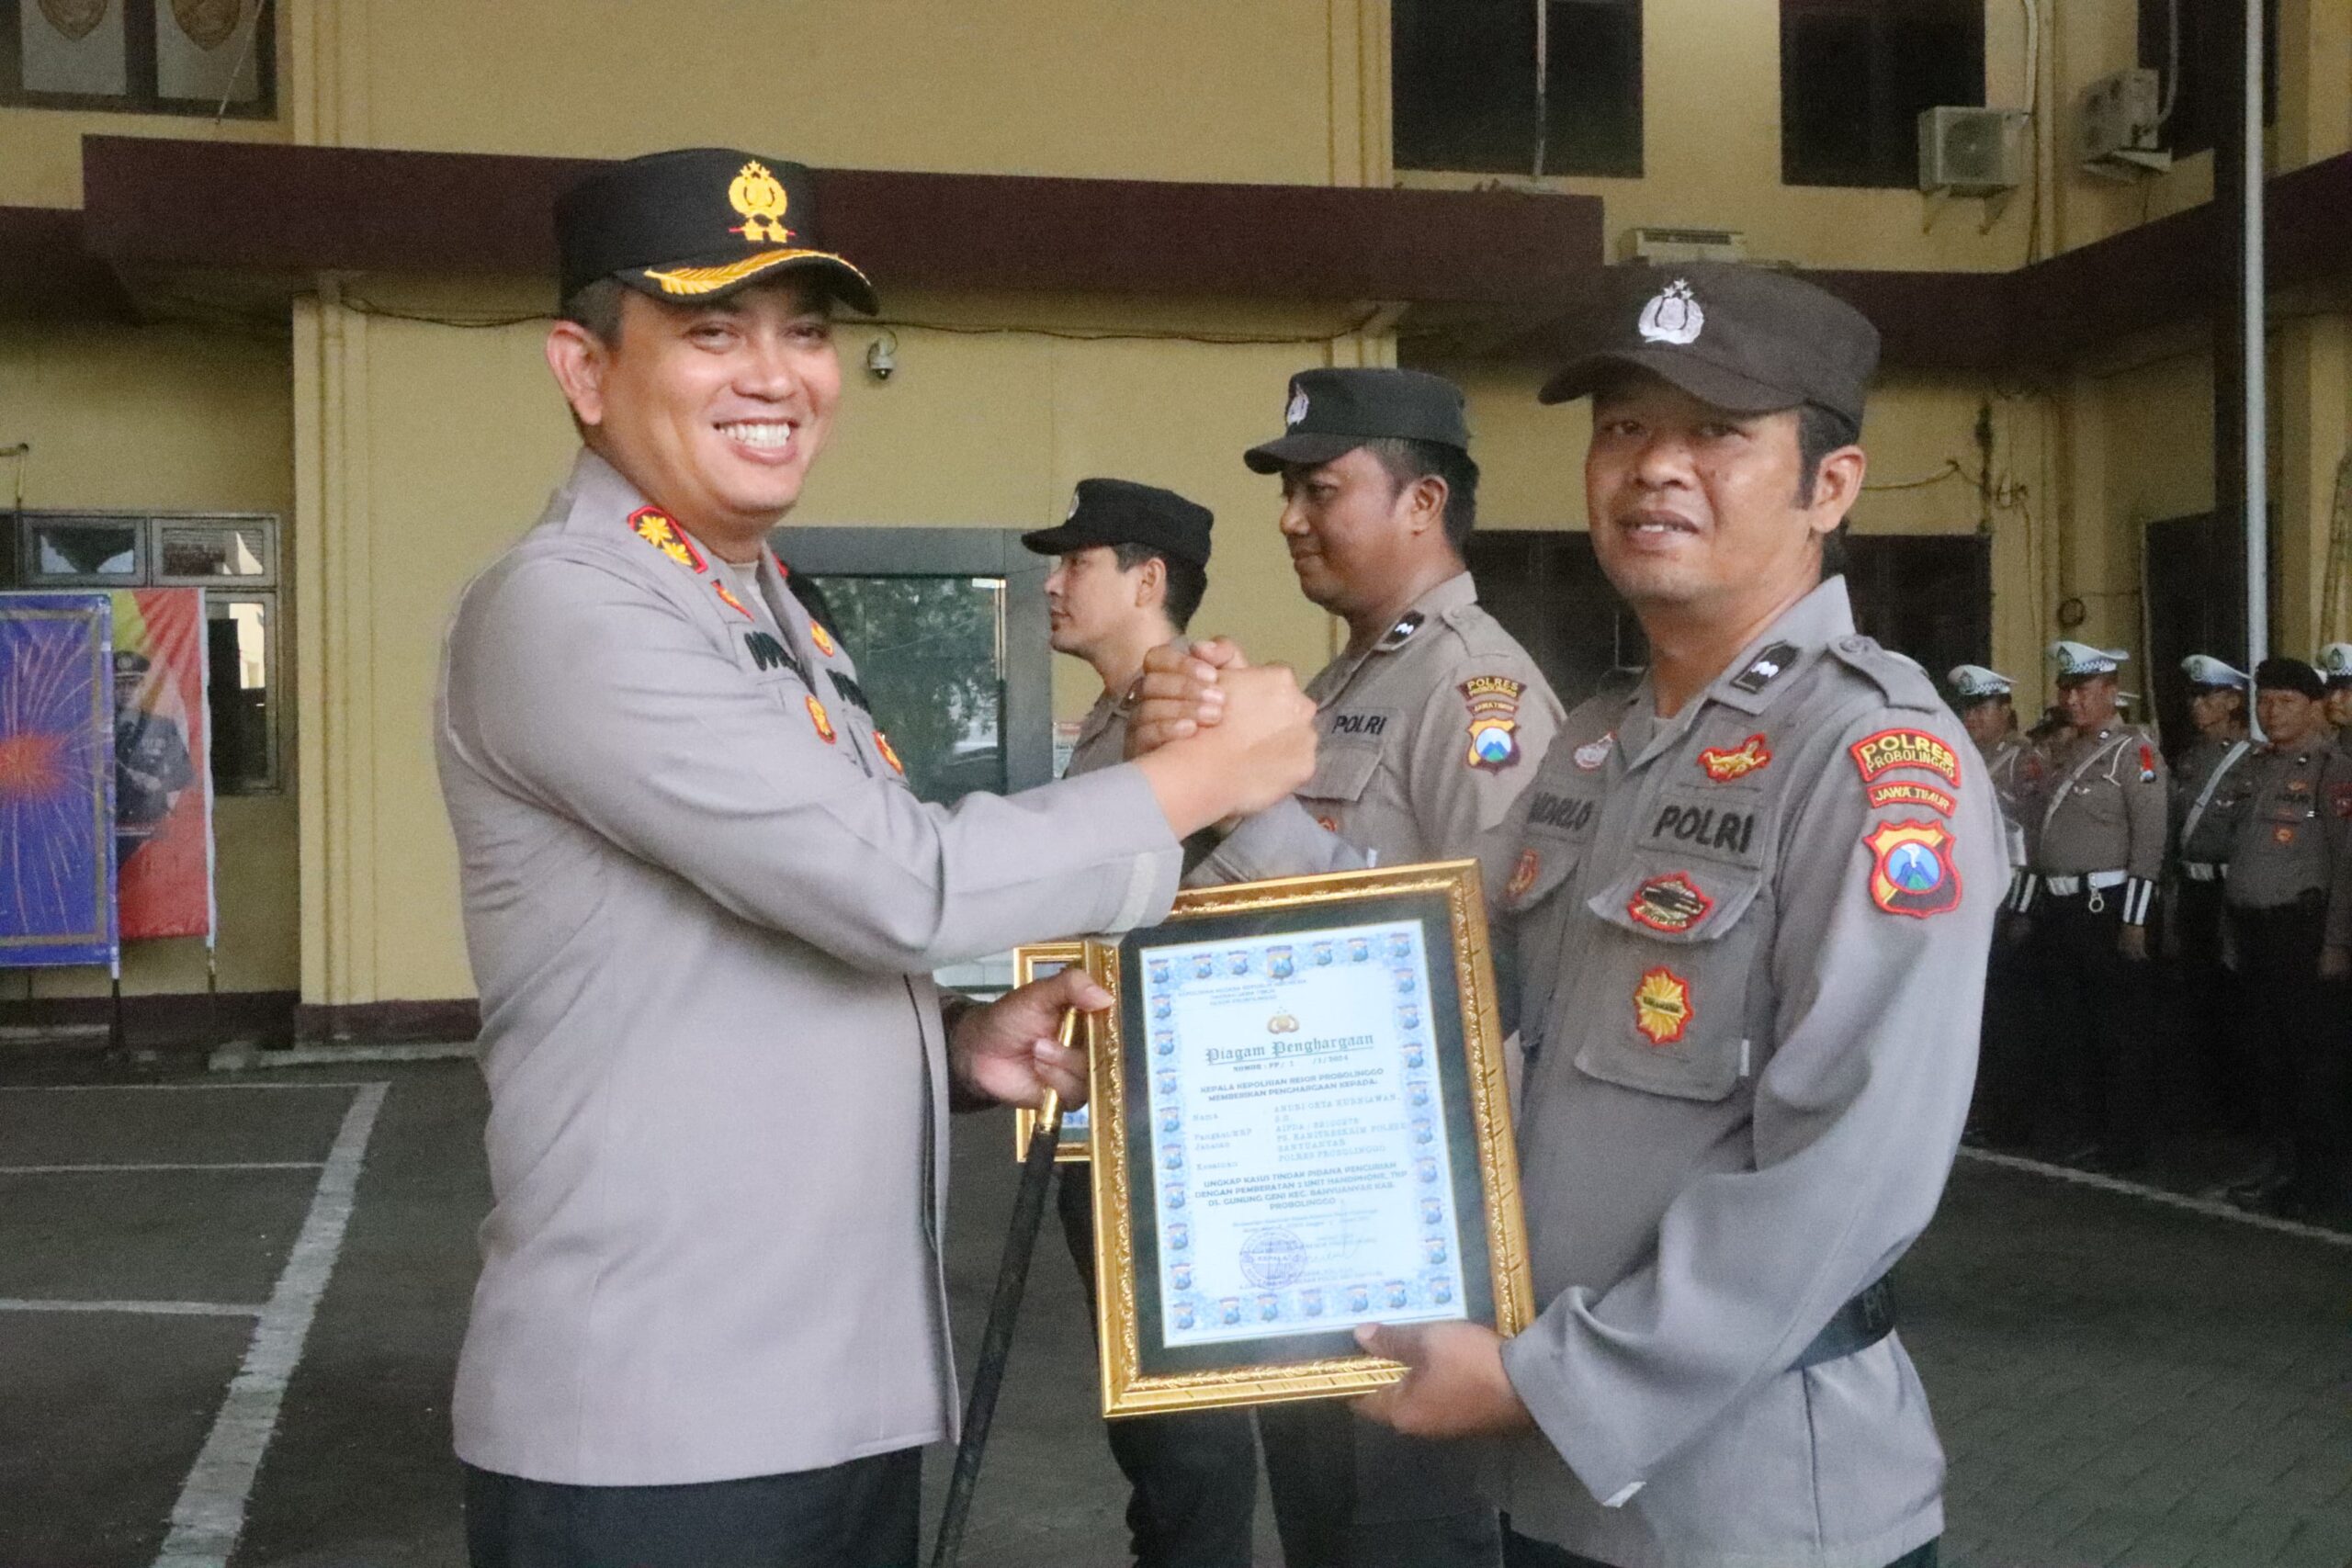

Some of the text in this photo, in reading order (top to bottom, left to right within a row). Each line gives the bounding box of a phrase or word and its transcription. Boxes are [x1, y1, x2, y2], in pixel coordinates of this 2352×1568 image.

[1467, 678, 1519, 691] POLRES
[1331, 715, 1387, 735] POLRI
[1860, 734, 1954, 768] POLRES
[1866, 749, 1955, 779] PROBOLINGGO
[1875, 786, 1950, 809] JAWA TIMUR
[1652, 805, 1754, 853] POLRI
[1205, 1035, 1374, 1063] Piagam Penghargaan
[1201, 1067, 1385, 1094] KEPALA KEPOLISIAN RESOR PROBOLINGGO
[1208, 1090, 1267, 1101] MEMBERIKAN
[1268, 1083, 1338, 1096] PENGHARGAAN
[1204, 1162, 1397, 1188] UNGKAP KASUS TINDAK PIDANA PENCURIAN
[1194, 1189, 1234, 1199] DENGAN
[1235, 1182, 1295, 1194] PEMBERATAN
[1304, 1179, 1326, 1188] UNIT
[1223, 1195, 1263, 1205] GUNUNG
[1264, 1191, 1287, 1201] GENI
[1269, 1197, 1337, 1210] PROBOLINGGO
